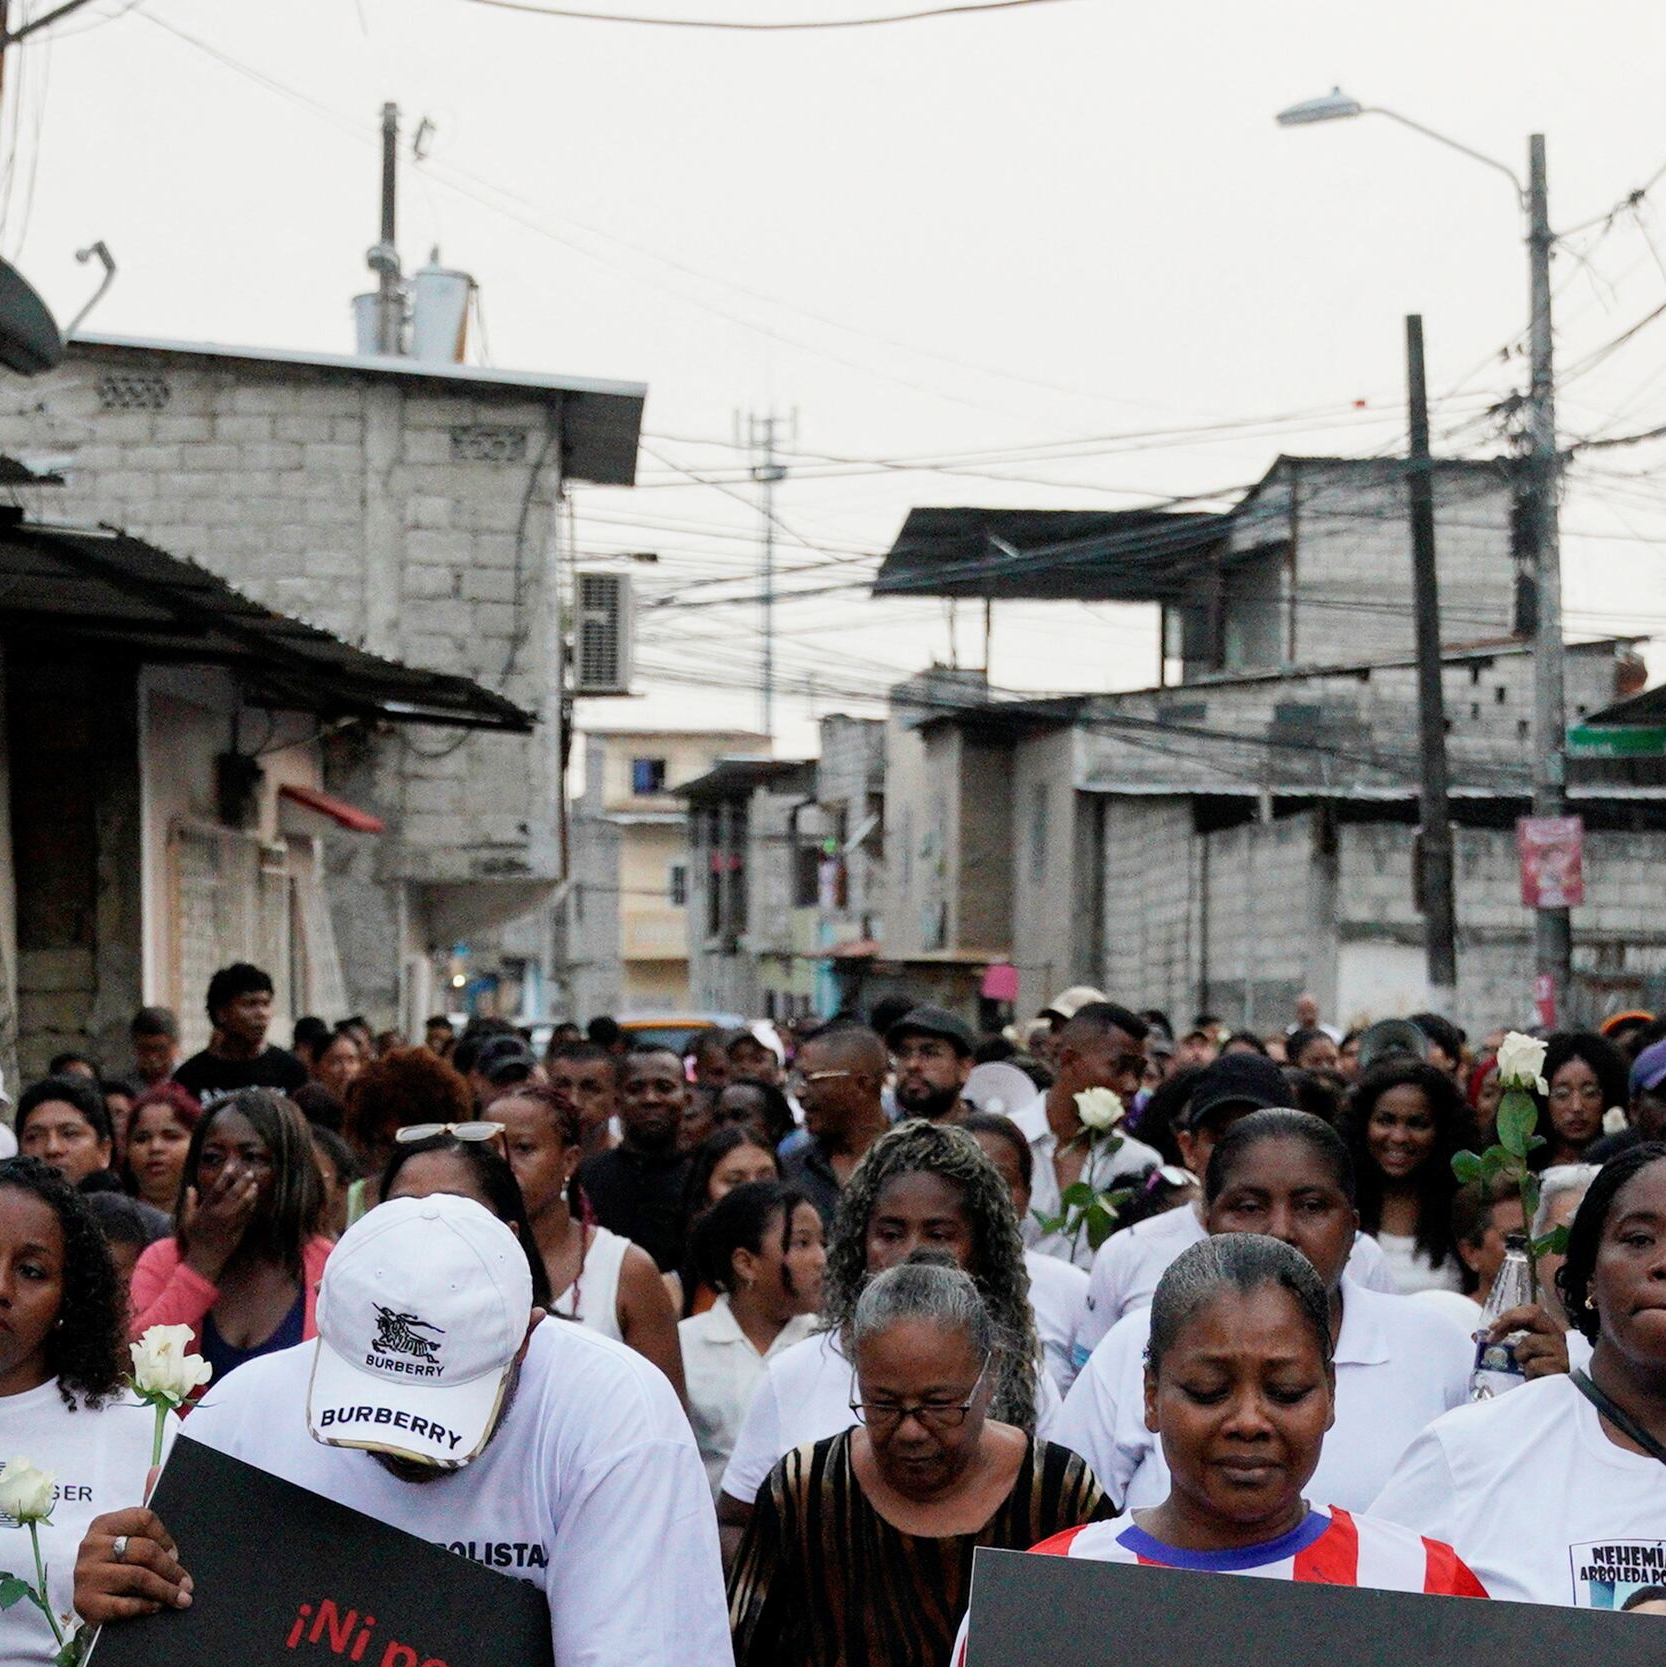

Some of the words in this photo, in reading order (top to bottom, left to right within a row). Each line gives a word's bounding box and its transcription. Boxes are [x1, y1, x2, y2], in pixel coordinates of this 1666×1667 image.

[366, 1354, 446, 1377] BURBERRY
[321, 1406, 463, 1450] BURBERRY
[1580, 1566, 1649, 1583] ARBOLEDA
[286, 1599, 377, 1661] ¡Ni
